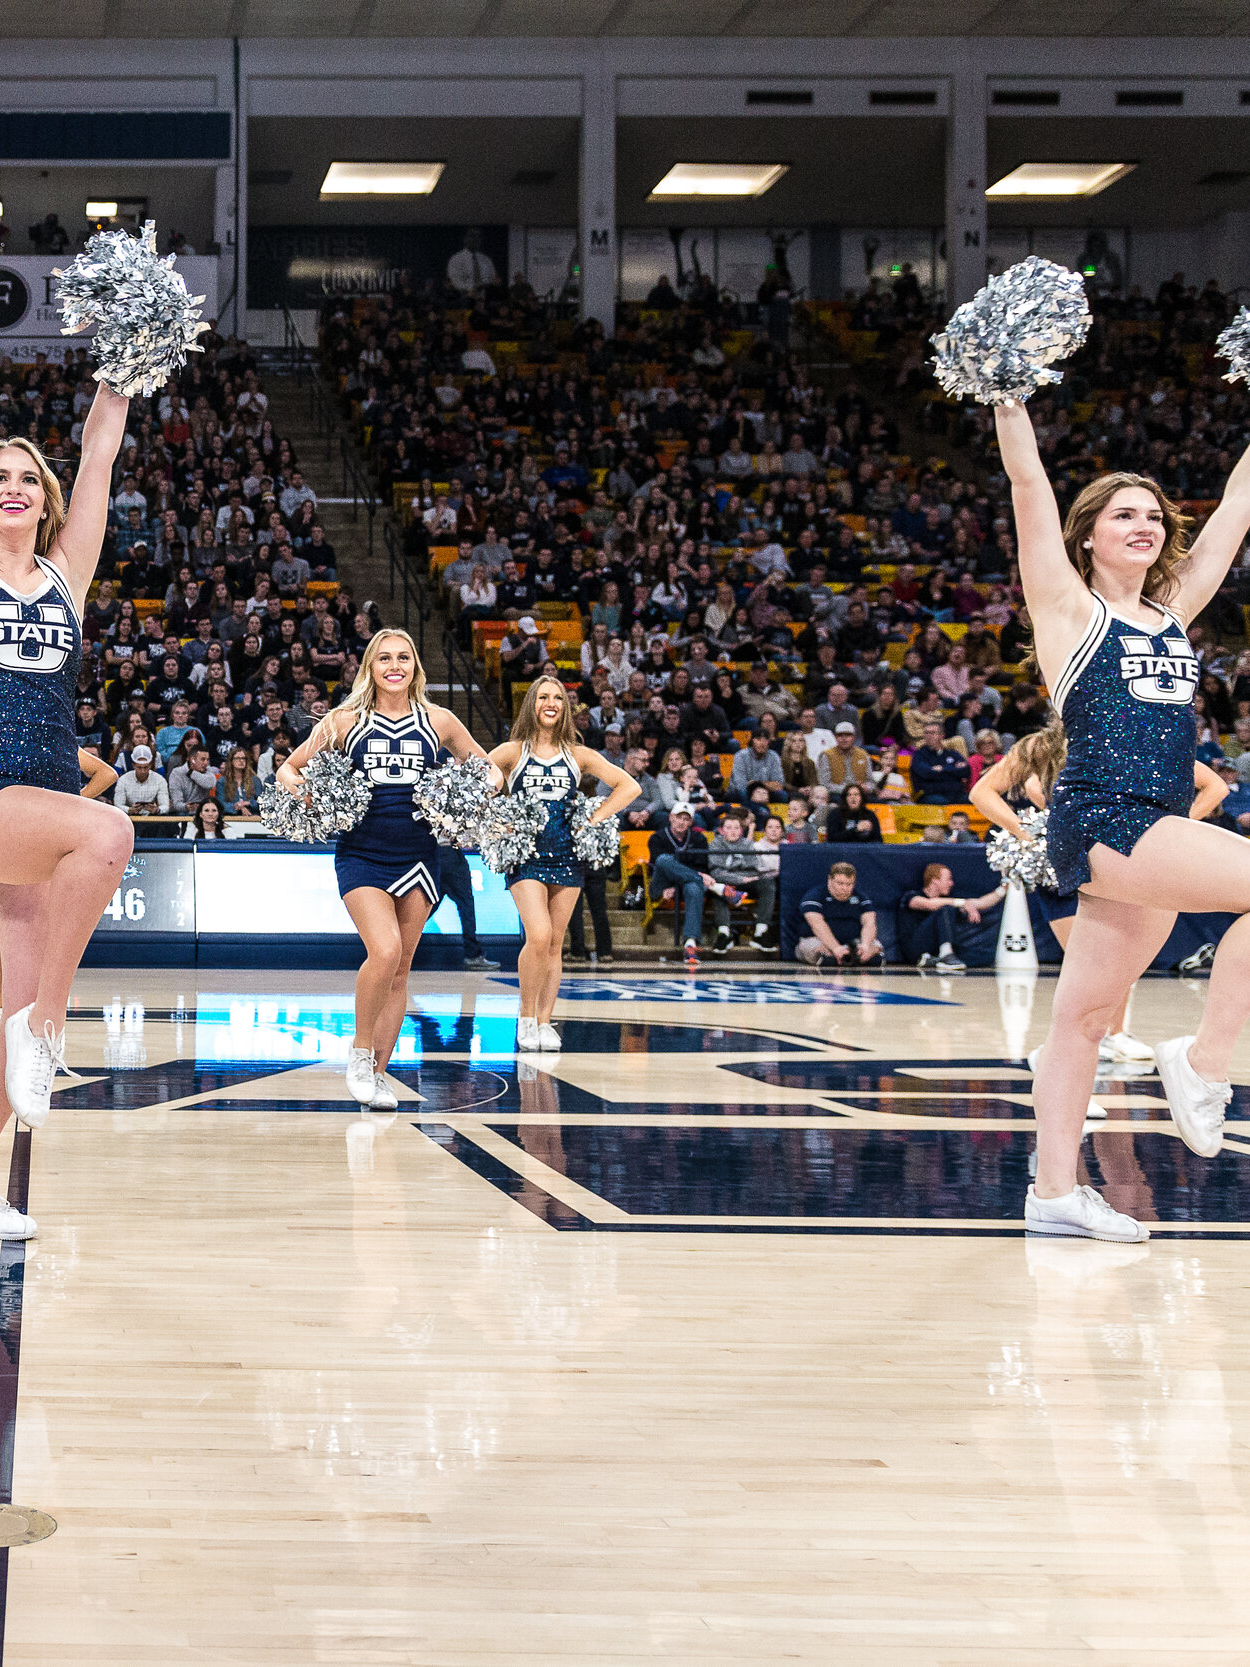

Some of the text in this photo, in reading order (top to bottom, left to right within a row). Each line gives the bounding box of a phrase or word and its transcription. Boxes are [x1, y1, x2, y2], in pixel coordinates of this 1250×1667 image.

[590, 229, 609, 246] M
[963, 230, 980, 247] N
[1119, 656, 1199, 682] STATE
[363, 753, 426, 771] STATE
[522, 775, 572, 790] STATE
[176, 881, 184, 895] 7
[103, 887, 146, 921] 46
[176, 911, 185, 927] 2
